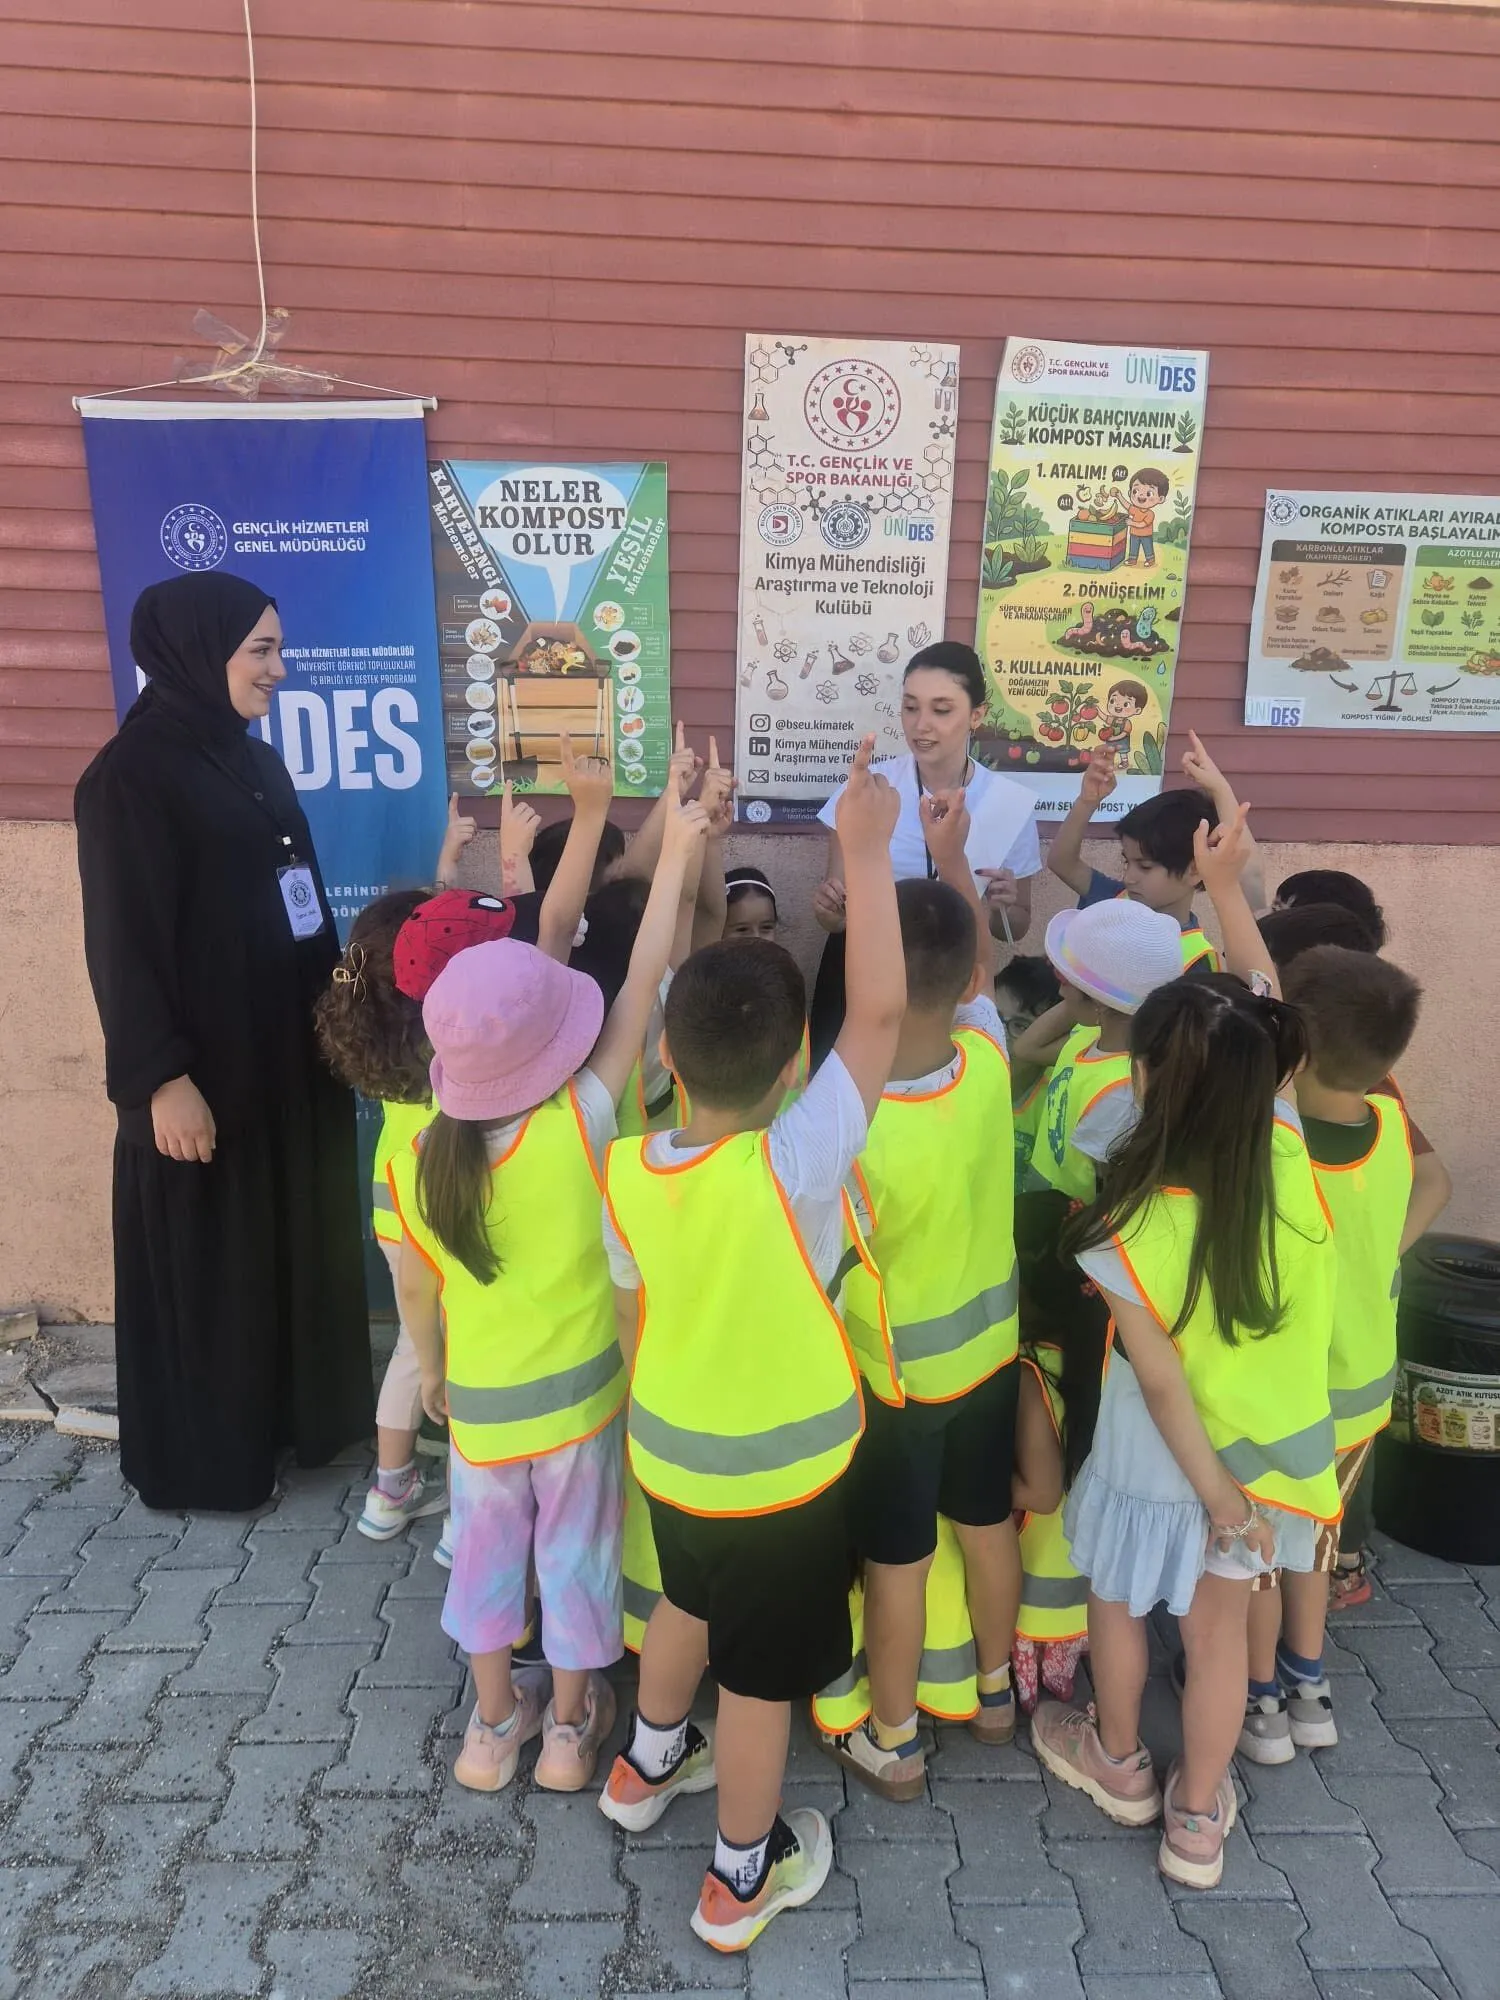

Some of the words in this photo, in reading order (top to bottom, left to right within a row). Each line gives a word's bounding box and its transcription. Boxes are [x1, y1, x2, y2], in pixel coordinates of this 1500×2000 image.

[1050, 358, 1062, 366] T.C.
[1064, 360, 1097, 370] GENÇLİK
[1048, 368, 1068, 376] SPOR
[1069, 368, 1109, 378] BAKANLIĞI
[1028, 402, 1079, 426] KÜÇÜK
[1083, 408, 1176, 430] BAHÇIVANIN
[1028, 427, 1104, 447] KOMPOST
[1108, 430, 1171, 450] MASALI!
[787, 454, 815, 468] T.C.
[820, 455, 888, 472] GENÇLİK
[892, 458, 912, 470] VE
[1037, 462, 1046, 478] 1.
[1050, 463, 1107, 480] ATALIM!
[786, 472, 826, 484] SPOR
[830, 472, 912, 488] BAKANLIĞI
[500, 480, 602, 502] NELER
[478, 506, 625, 529] KOMPOST
[1300, 505, 1370, 518] ORGANİK
[1374, 508, 1444, 522] ATIKLARI
[232, 520, 290, 536] GENÇLİK
[292, 518, 369, 534] HİZMETLERİ
[430, 468, 503, 588] KAHVERENGİ
[1320, 522, 1404, 536] KOMPOSTA
[234, 540, 277, 552] GENEL
[280, 538, 366, 552] MÜDÜRLÜĞÜ
[432, 502, 480, 580] Malzemeler
[512, 532, 594, 556] OLUR
[1296, 544, 1344, 553] KARBONLU
[1346, 545, 1384, 554] ATIKLAR
[606, 516, 652, 584] YEŞİL
[624, 518, 666, 596] Malzemeler
[1448, 550, 1482, 558] AZOTLU
[1484, 550, 1500, 558] ATI
[766, 552, 816, 574] Kimya
[820, 554, 926, 577] Mühendisliği
[755, 576, 836, 596] Araştırma
[841, 582, 858, 594] ve
[862, 580, 934, 598] Teknoloji
[1063, 584, 1075, 597] 2.
[1078, 582, 1165, 604] DÖNÜŞELİM!
[816, 600, 872, 615] Kulübü
[282, 647, 310, 659] GENÇLİK
[312, 646, 350, 658] HİZMETLERİ
[352, 648, 371, 657] GENEL
[372, 645, 414, 657] MÜDÜRLÜĞÜ
[296, 660, 337, 672] ÜNİVERSİTE
[368, 660, 416, 670] TOPLULUKLARI
[994, 660, 1006, 674] 3.
[1010, 660, 1102, 676] KULLANALIM!
[345, 675, 353, 684] VE
[355, 675, 379, 684] DESTEK
[380, 675, 416, 684] PROGRAMI
[1008, 676, 1049, 687] DOĞAMIZIN
[1008, 687, 1025, 696] YENİ
[776, 719, 854, 731] @bseu.kimatek
[775, 739, 806, 751] Kimya
[774, 753, 826, 765] Araştırma
[828, 756, 840, 764] ve
[774, 772, 848, 784] bseukimatek@
[1456, 1390, 1472, 1398] ATIK
